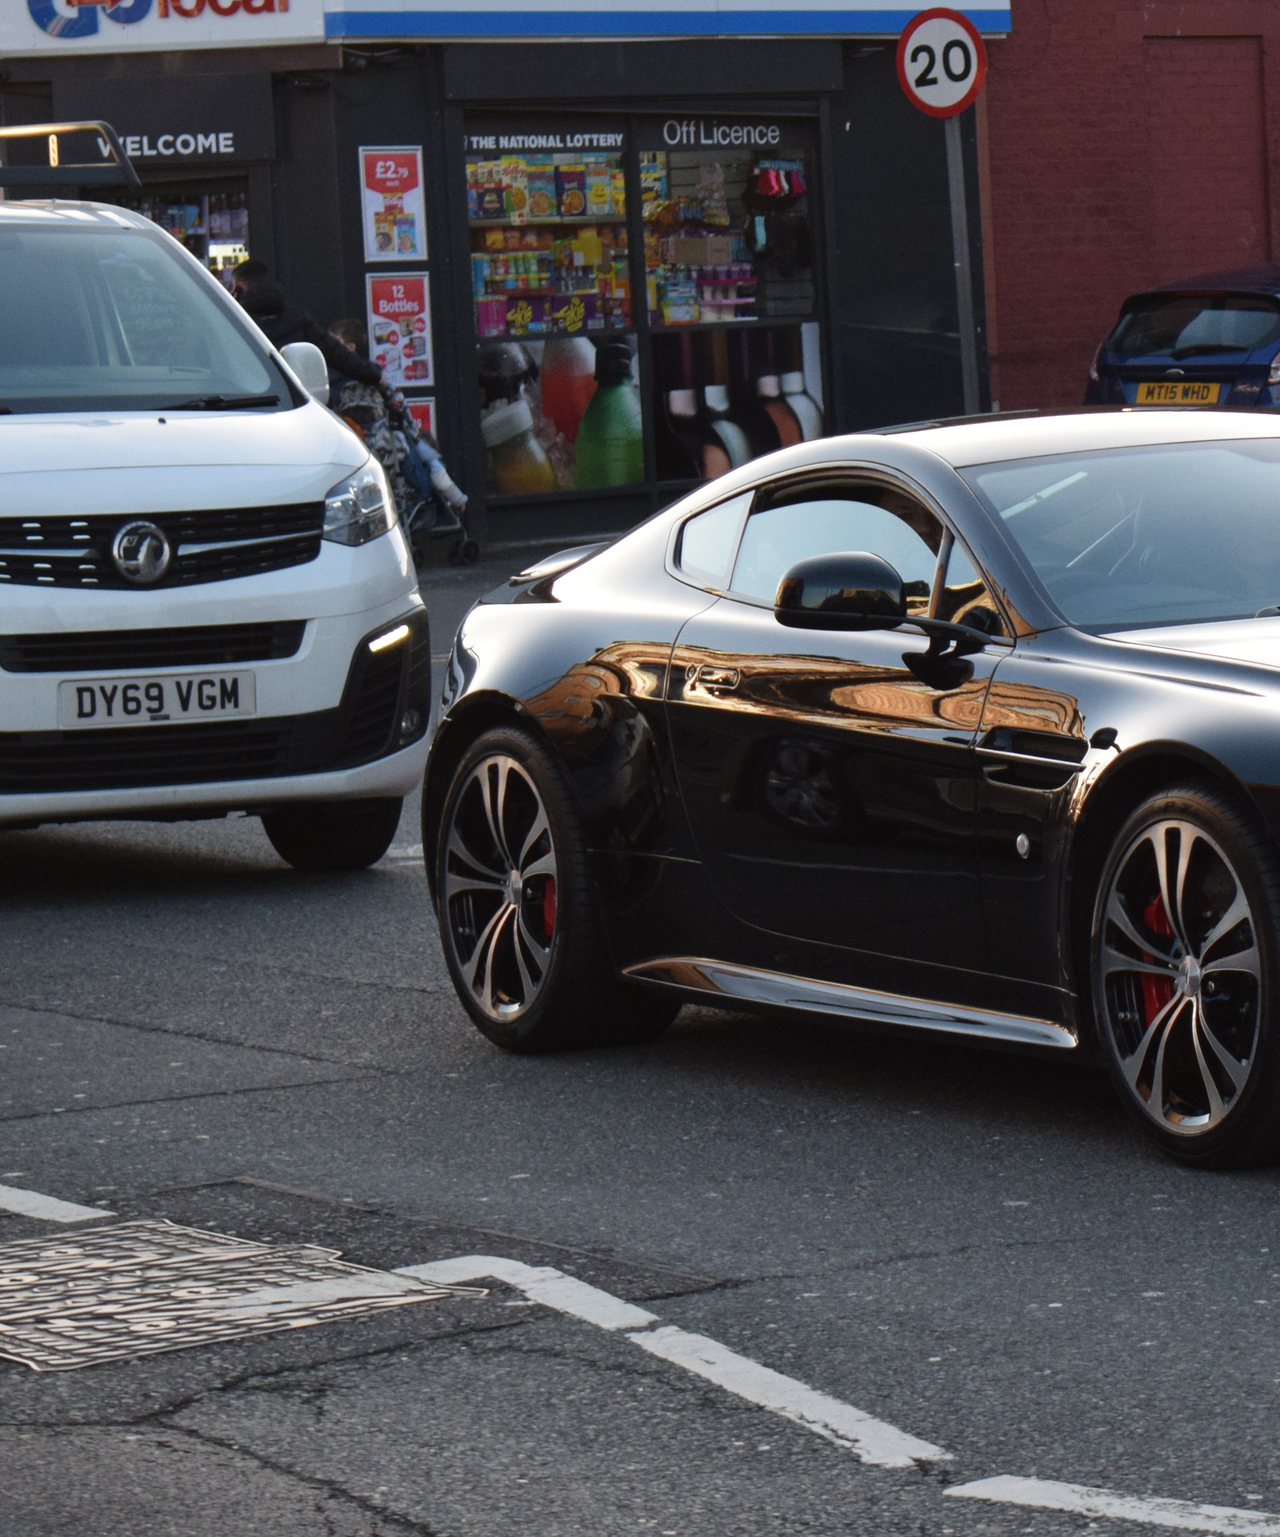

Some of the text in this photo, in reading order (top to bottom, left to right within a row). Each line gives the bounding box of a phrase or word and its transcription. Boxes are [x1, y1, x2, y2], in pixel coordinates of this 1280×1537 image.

[910, 39, 972, 88] 20
[470, 133, 624, 149] THE NATIONAL LOTTERY
[663, 120, 780, 145] Off Licence
[375, 160, 409, 179] £2.79
[391, 285, 405, 298] 12
[379, 299, 419, 313] Bottles
[1145, 385, 1210, 400] MT15 WHD
[76, 677, 239, 719] DY69 VGM
